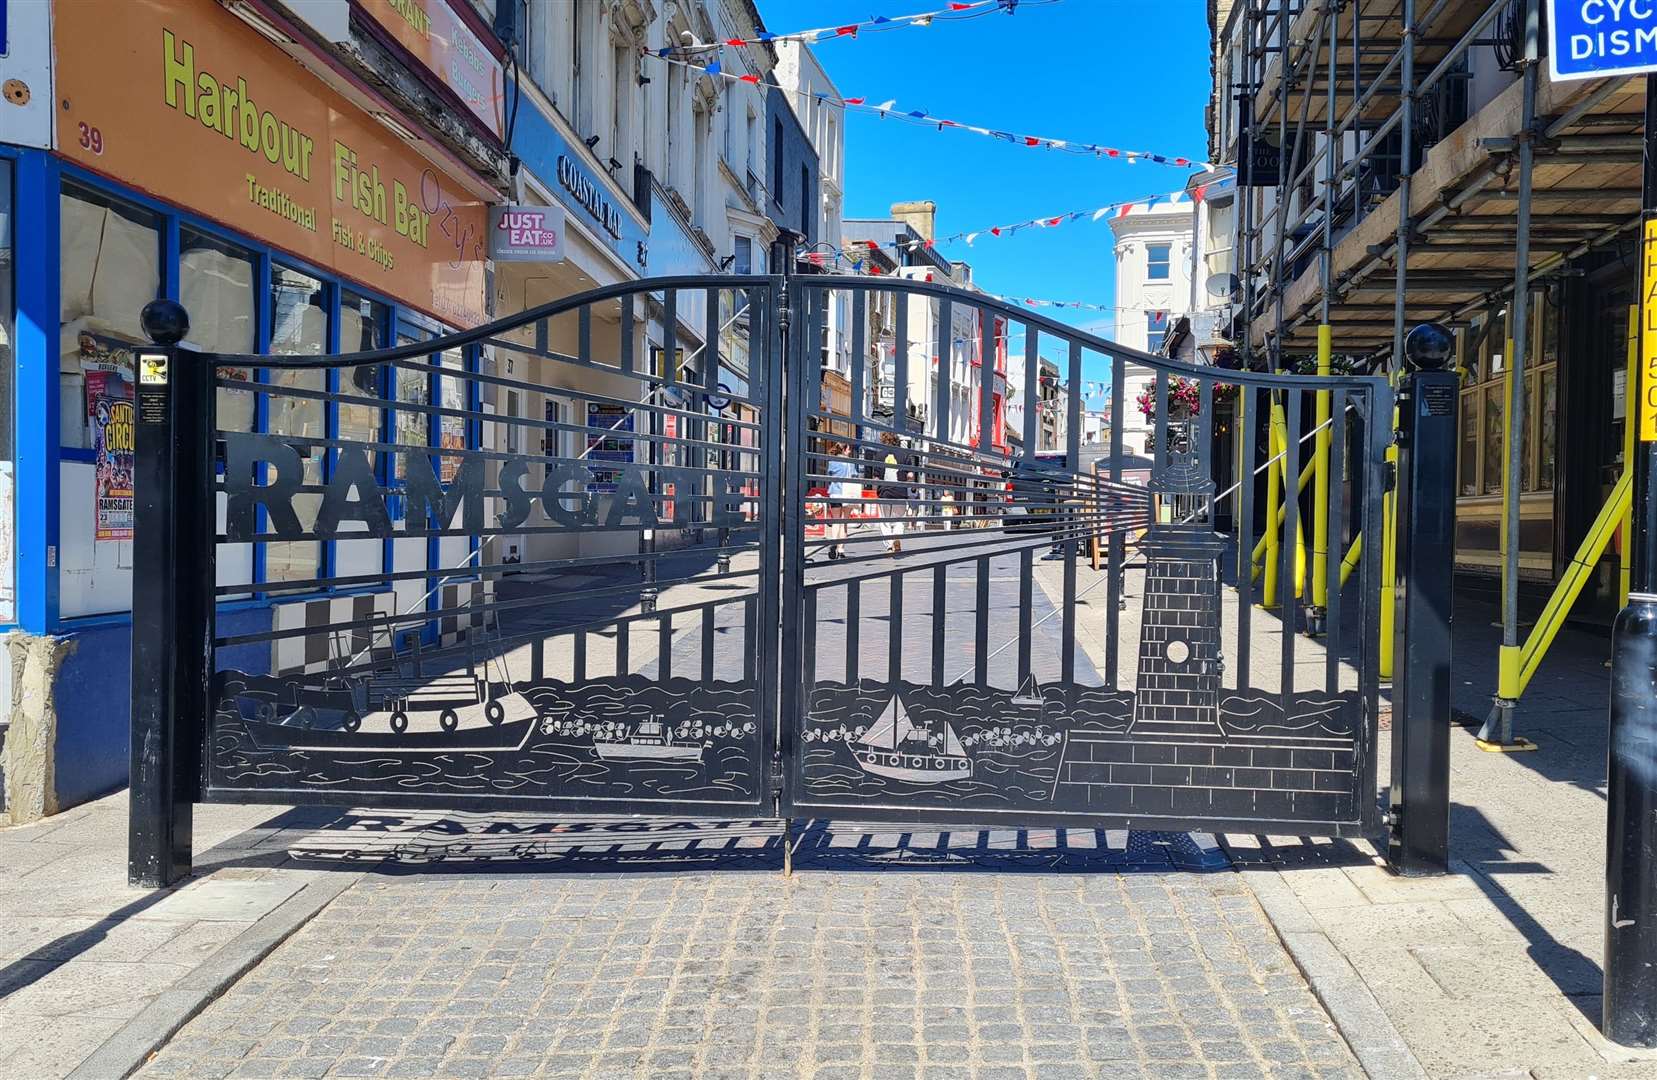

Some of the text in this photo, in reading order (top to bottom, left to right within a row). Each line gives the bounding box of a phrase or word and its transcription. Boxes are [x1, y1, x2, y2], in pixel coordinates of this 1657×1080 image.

[450, 25, 487, 77] Kebabs
[162, 28, 315, 182] Harbour
[451, 60, 487, 113] Burgers
[78, 121, 104, 155] 39
[246, 173, 317, 233] Traditional
[333, 140, 431, 249] Fish Bar
[421, 168, 482, 271] Ozy's
[558, 155, 624, 241] COASTAL BAR
[331, 217, 395, 271] Fish & Chips
[499, 213, 545, 230] JUST
[510, 230, 542, 246] EAT
[141, 374, 157, 382] CCTV
[99, 498, 133, 511] RAMSGATE
[226, 433, 748, 540] RAMSGATE
